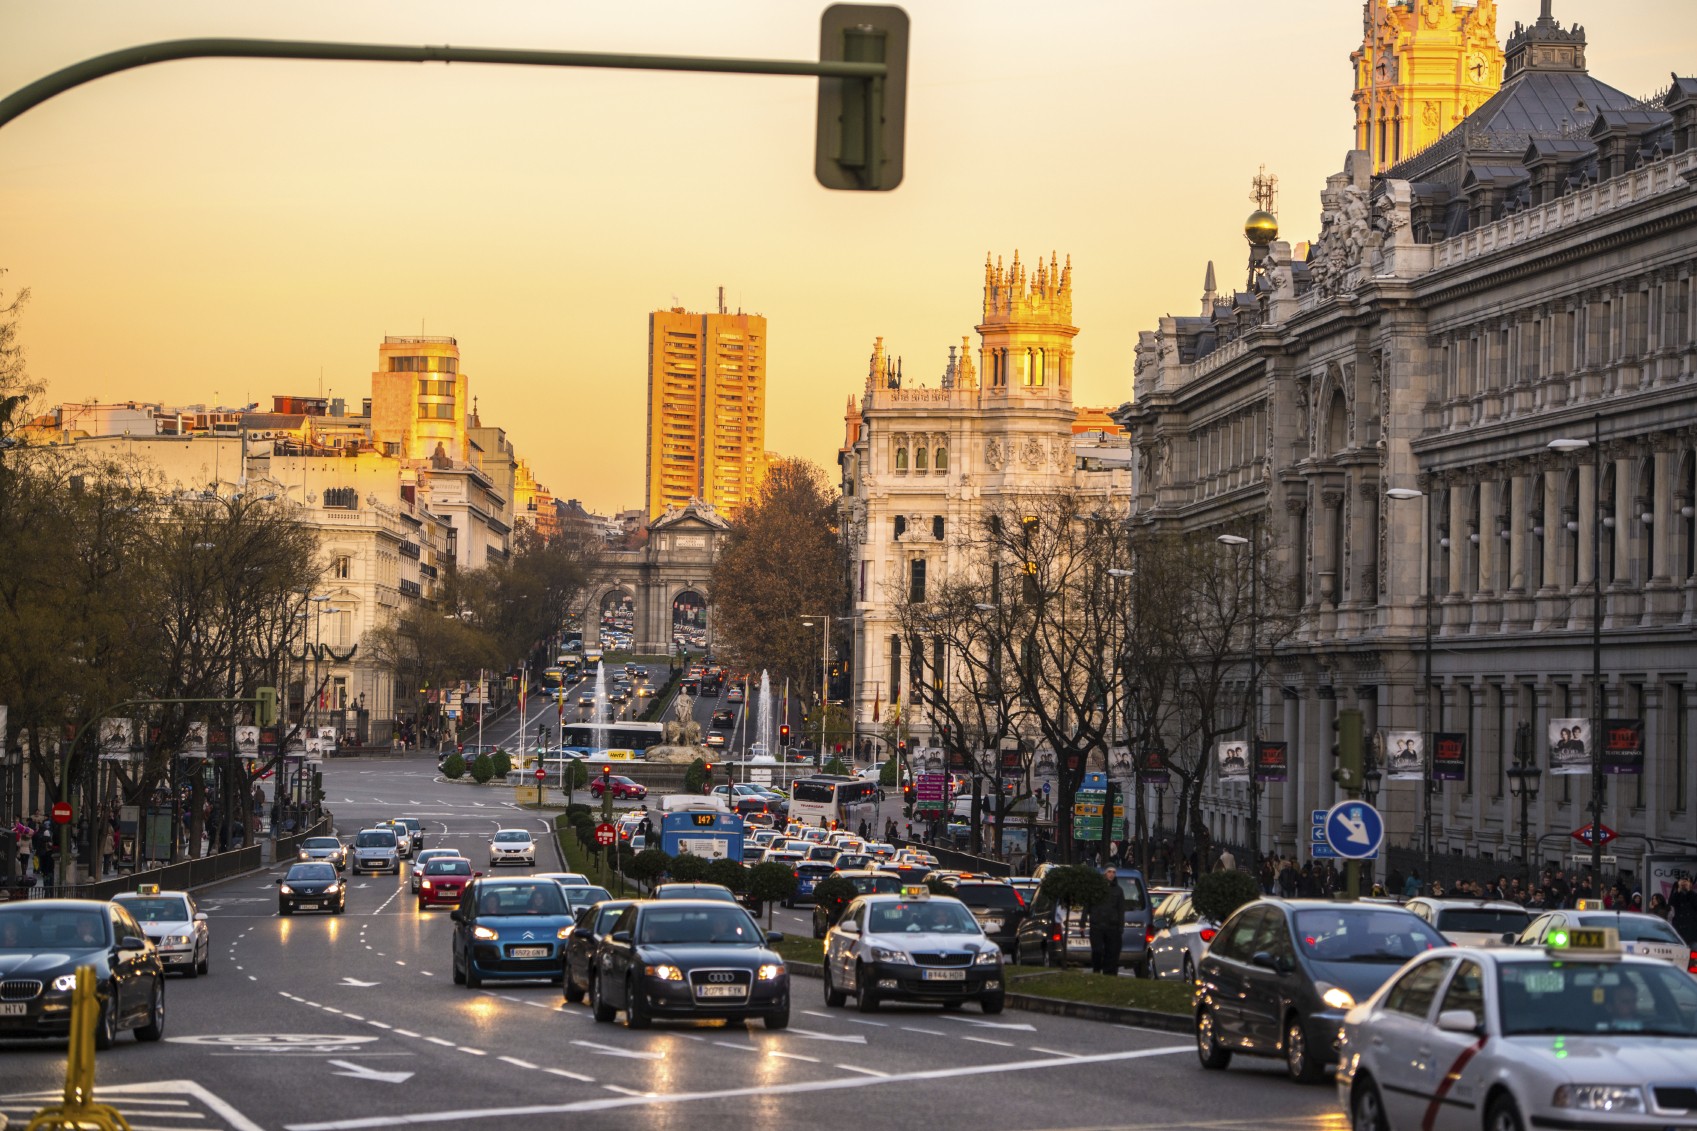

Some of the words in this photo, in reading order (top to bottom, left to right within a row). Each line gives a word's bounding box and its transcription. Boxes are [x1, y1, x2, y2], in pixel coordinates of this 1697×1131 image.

[698, 815, 711, 824] 147
[1570, 931, 1604, 947] TAXI
[5, 1004, 24, 1014] HTV
